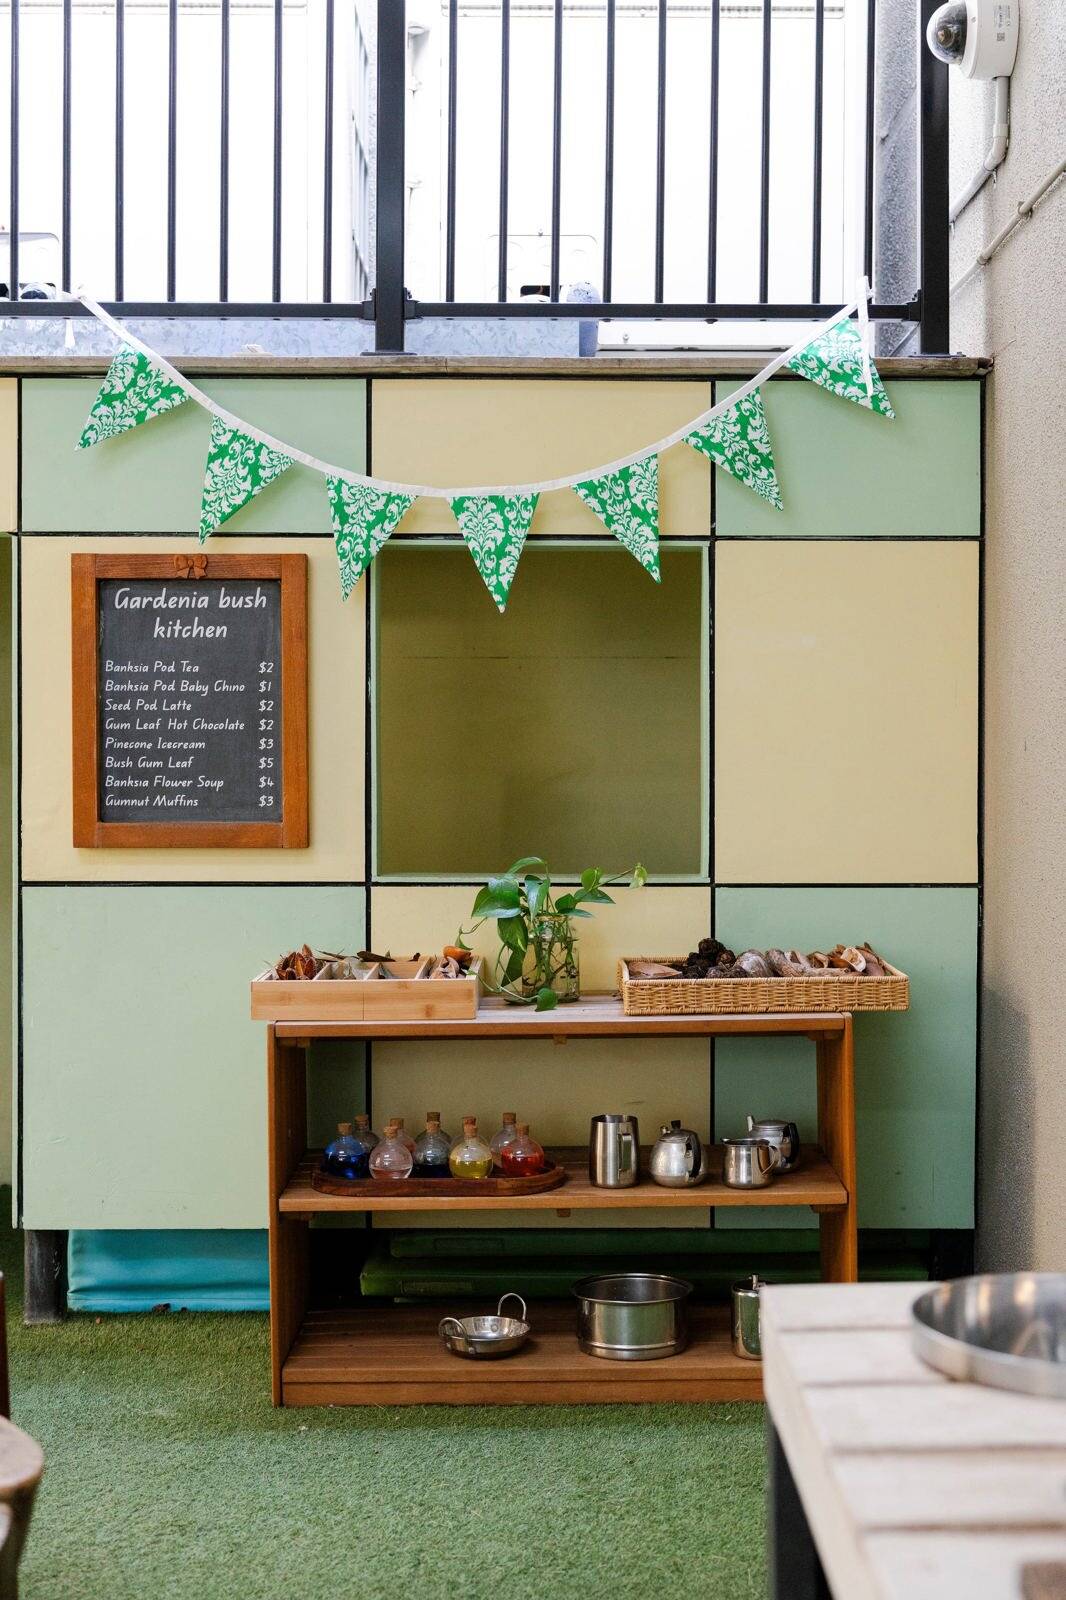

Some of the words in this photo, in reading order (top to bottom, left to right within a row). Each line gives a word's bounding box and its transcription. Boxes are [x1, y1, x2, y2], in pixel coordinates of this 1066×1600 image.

[115, 588, 209, 609] Gardenia
[219, 587, 266, 608] bush
[154, 617, 227, 638] kitchen
[106, 660, 148, 672] Banksia
[154, 661, 175, 672] Pod
[181, 661, 199, 672] Tea
[259, 661, 273, 673] $2
[106, 680, 148, 691] Banksia
[154, 680, 175, 691] Pod
[180, 680, 208, 696] Baby
[214, 680, 245, 691] Chino
[259, 681, 271, 692] $1
[105, 699, 131, 710] Seed
[136, 699, 157, 710] Pod
[163, 699, 191, 710] Latte
[259, 700, 274, 712] $2
[106, 718, 130, 729] Gum
[136, 718, 161, 729] Leaf
[168, 718, 188, 729] Hot
[193, 718, 244, 730] Chocolate
[259, 719, 273, 731] $2
[106, 737, 152, 749] Pinecone
[157, 738, 205, 749] Icecream
[259, 738, 273, 750] $3
[106, 756, 132, 767] Bush
[138, 756, 163, 768] Gum
[168, 756, 194, 768] Leaf
[259, 757, 274, 769] $5
[106, 775, 149, 787] Banksia
[154, 776, 193, 787] Flower
[197, 776, 224, 791] Soup
[259, 776, 274, 788] $4
[106, 795, 149, 806] Gumnut
[153, 795, 198, 806] Muffins
[259, 795, 273, 807] $3
